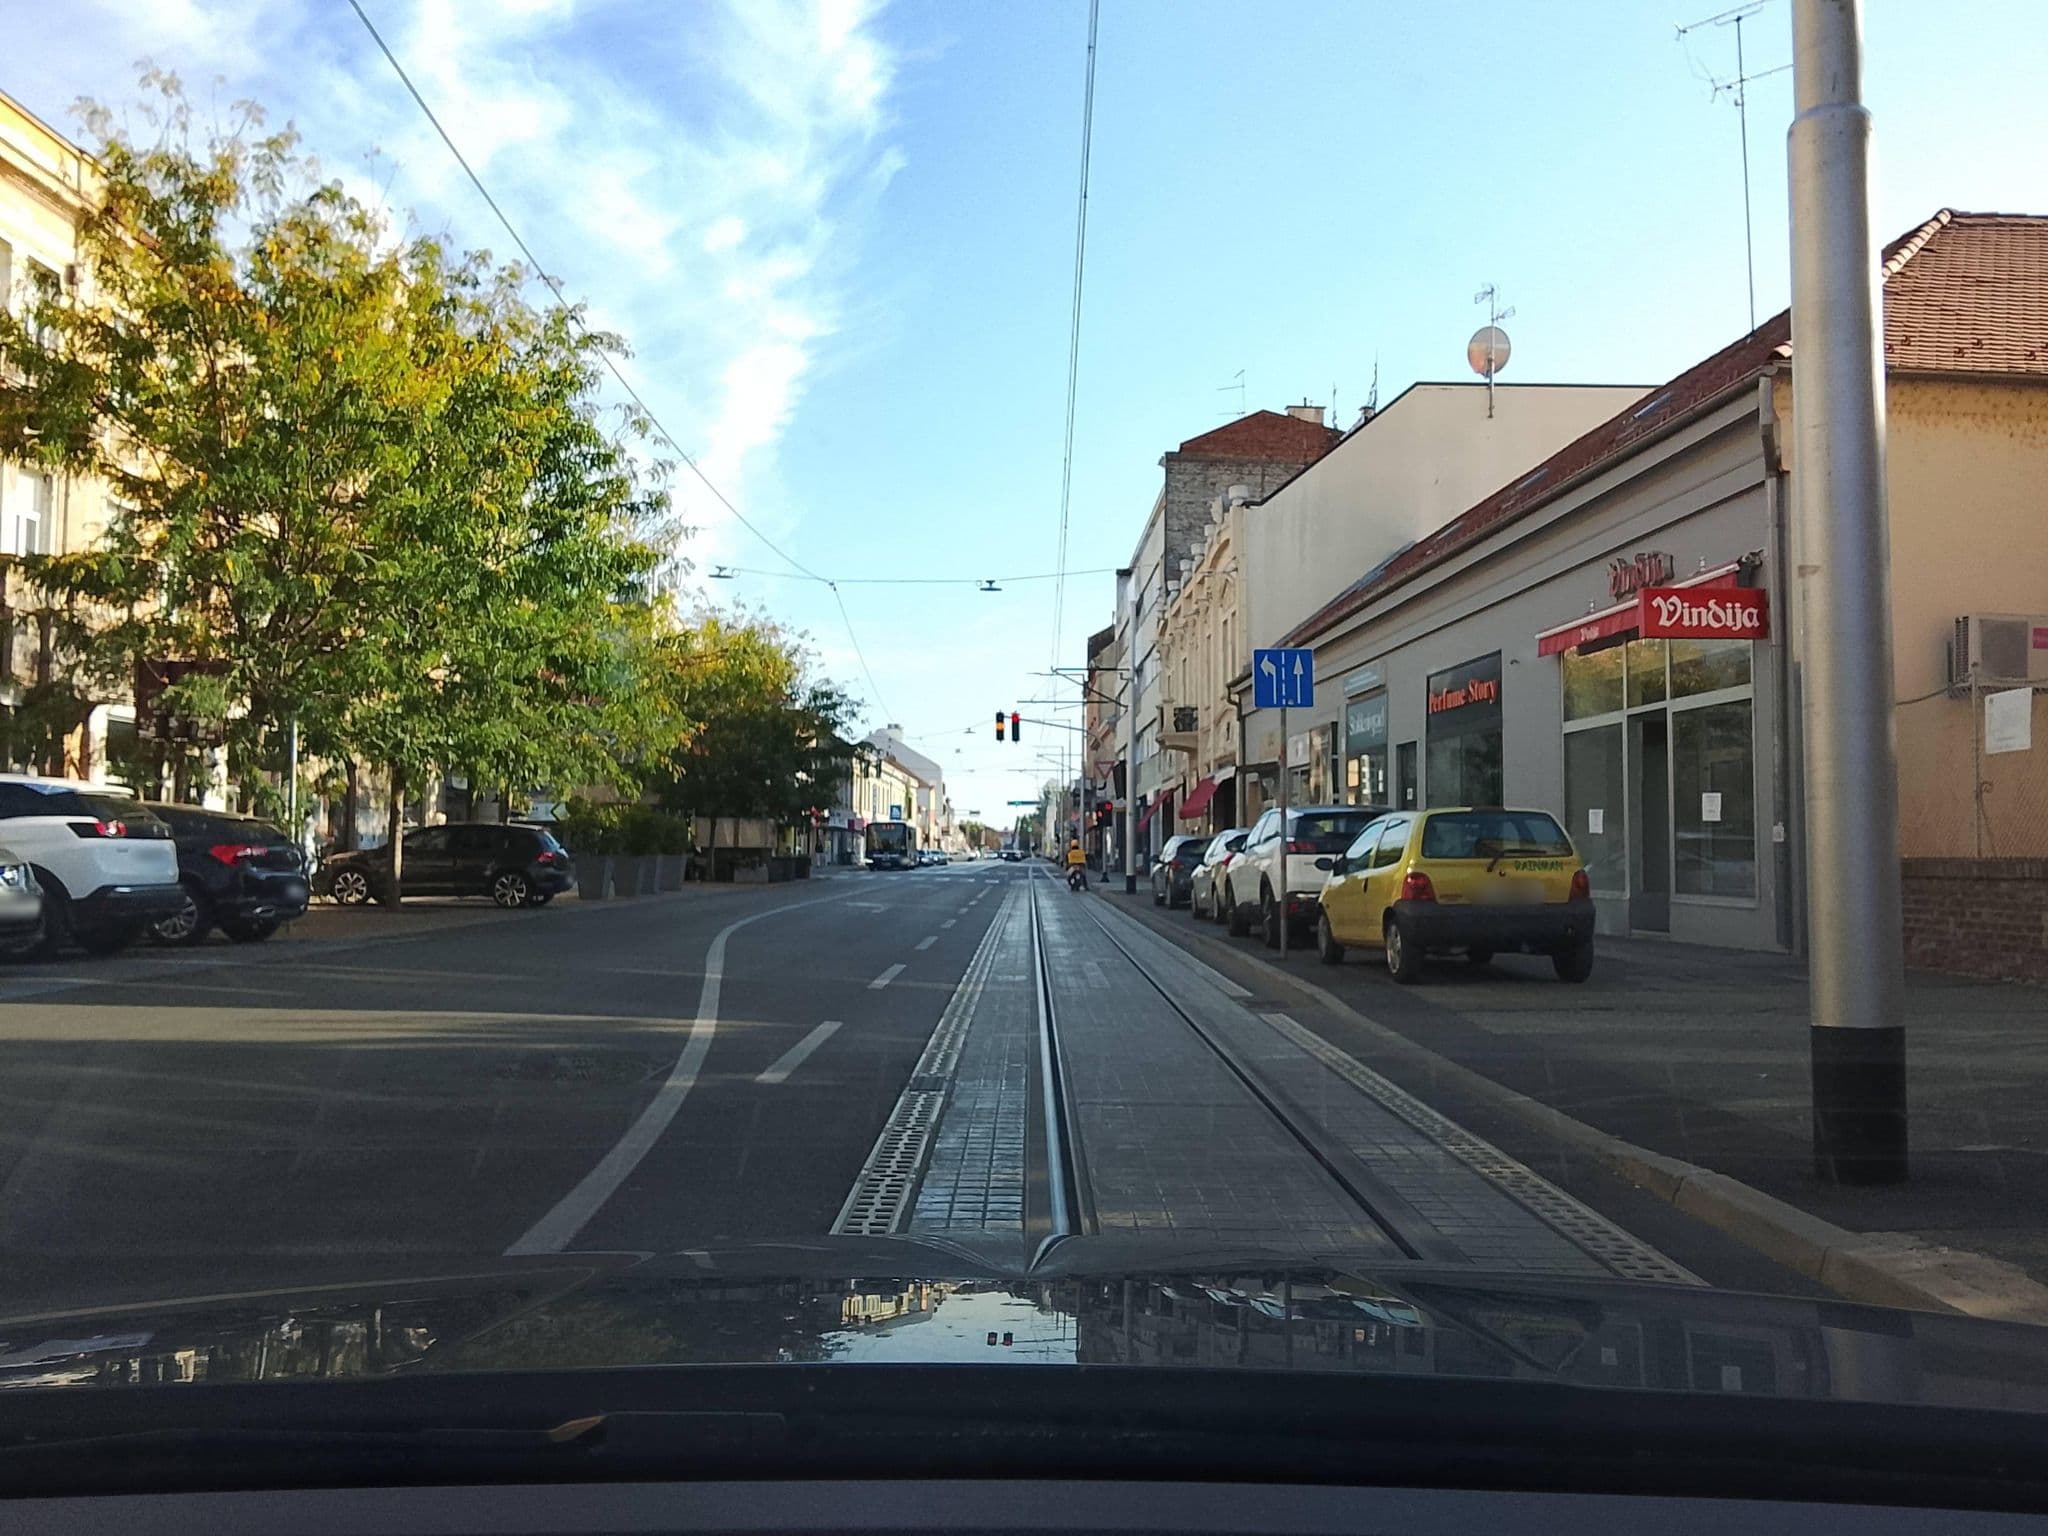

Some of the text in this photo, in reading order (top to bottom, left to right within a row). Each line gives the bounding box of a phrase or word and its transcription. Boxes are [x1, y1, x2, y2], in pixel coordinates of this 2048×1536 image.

[1651, 595, 1760, 632] Vindija
[1428, 679, 1498, 714] Perfume Story
